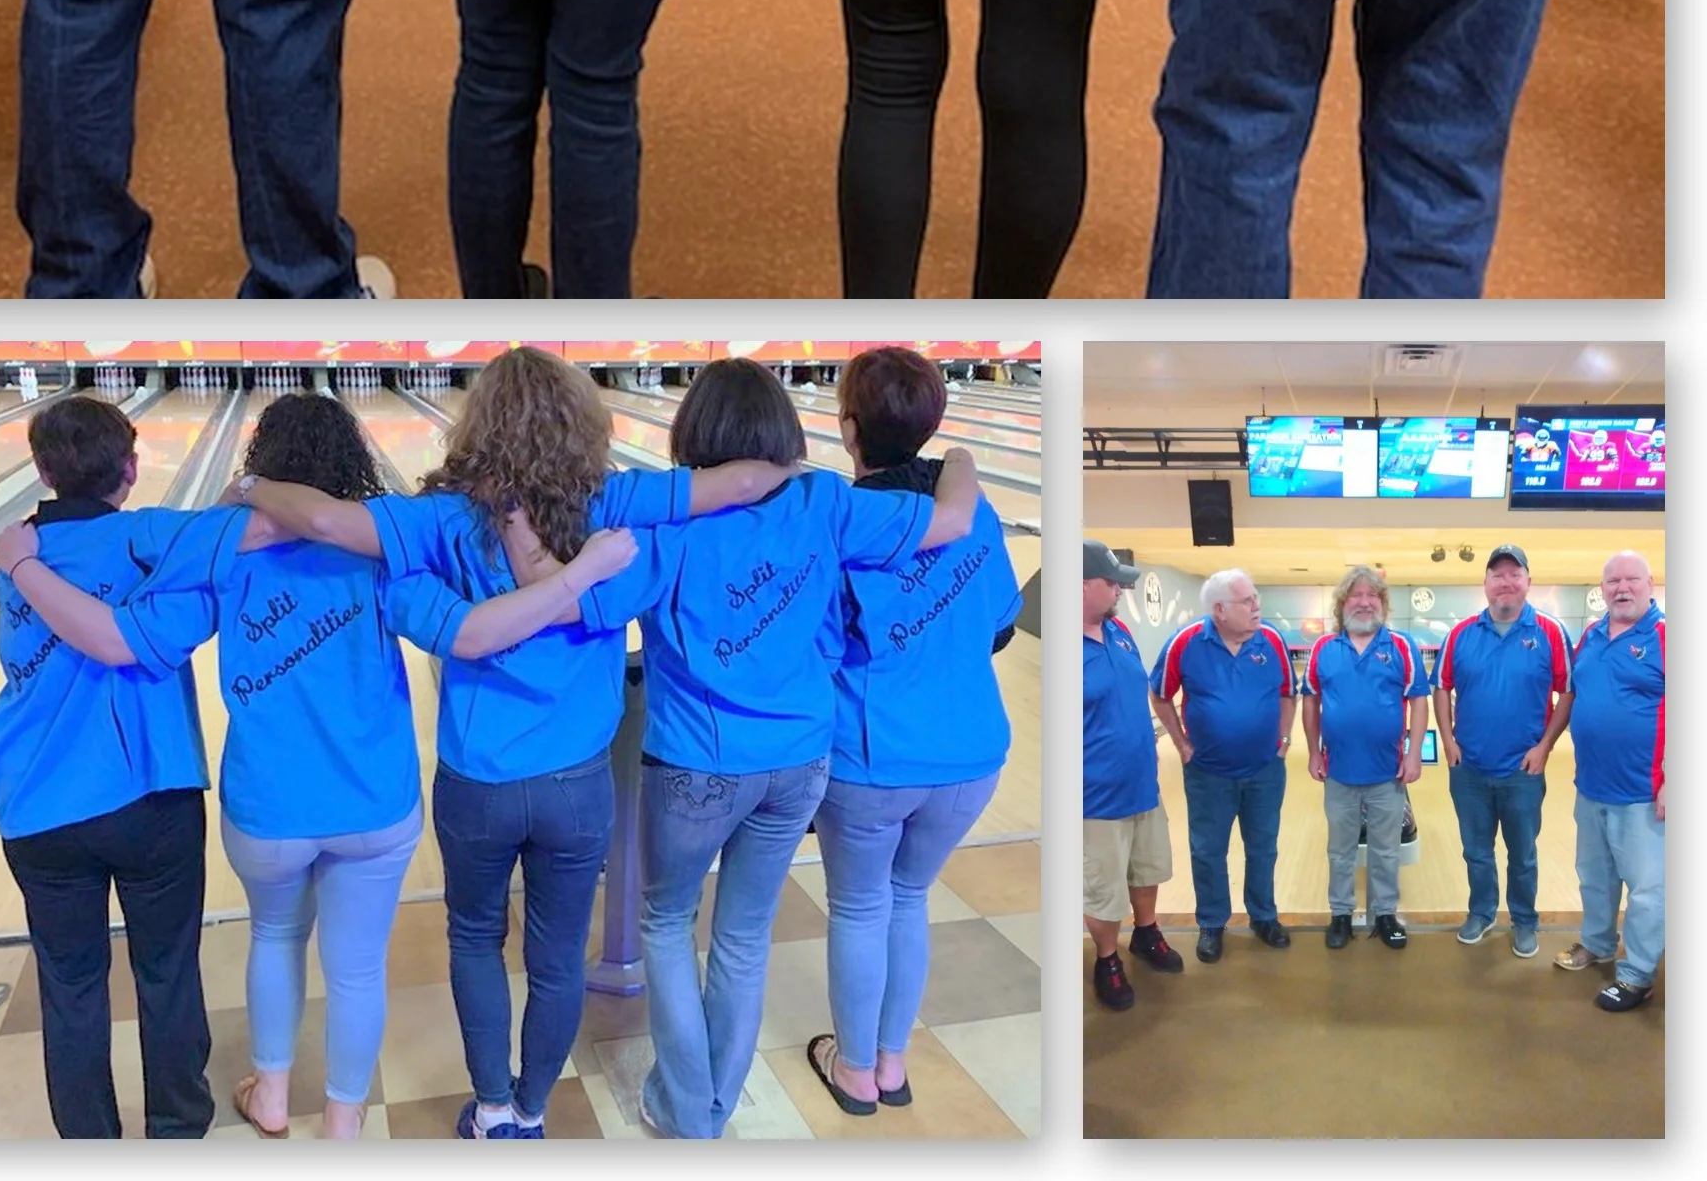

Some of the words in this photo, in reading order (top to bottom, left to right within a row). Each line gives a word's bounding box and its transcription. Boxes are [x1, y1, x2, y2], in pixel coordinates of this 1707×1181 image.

[240, 590, 300, 644] Split
[725, 559, 777, 610] Split
[888, 544, 991, 652] Personalities
[231, 601, 364, 707] Personalities
